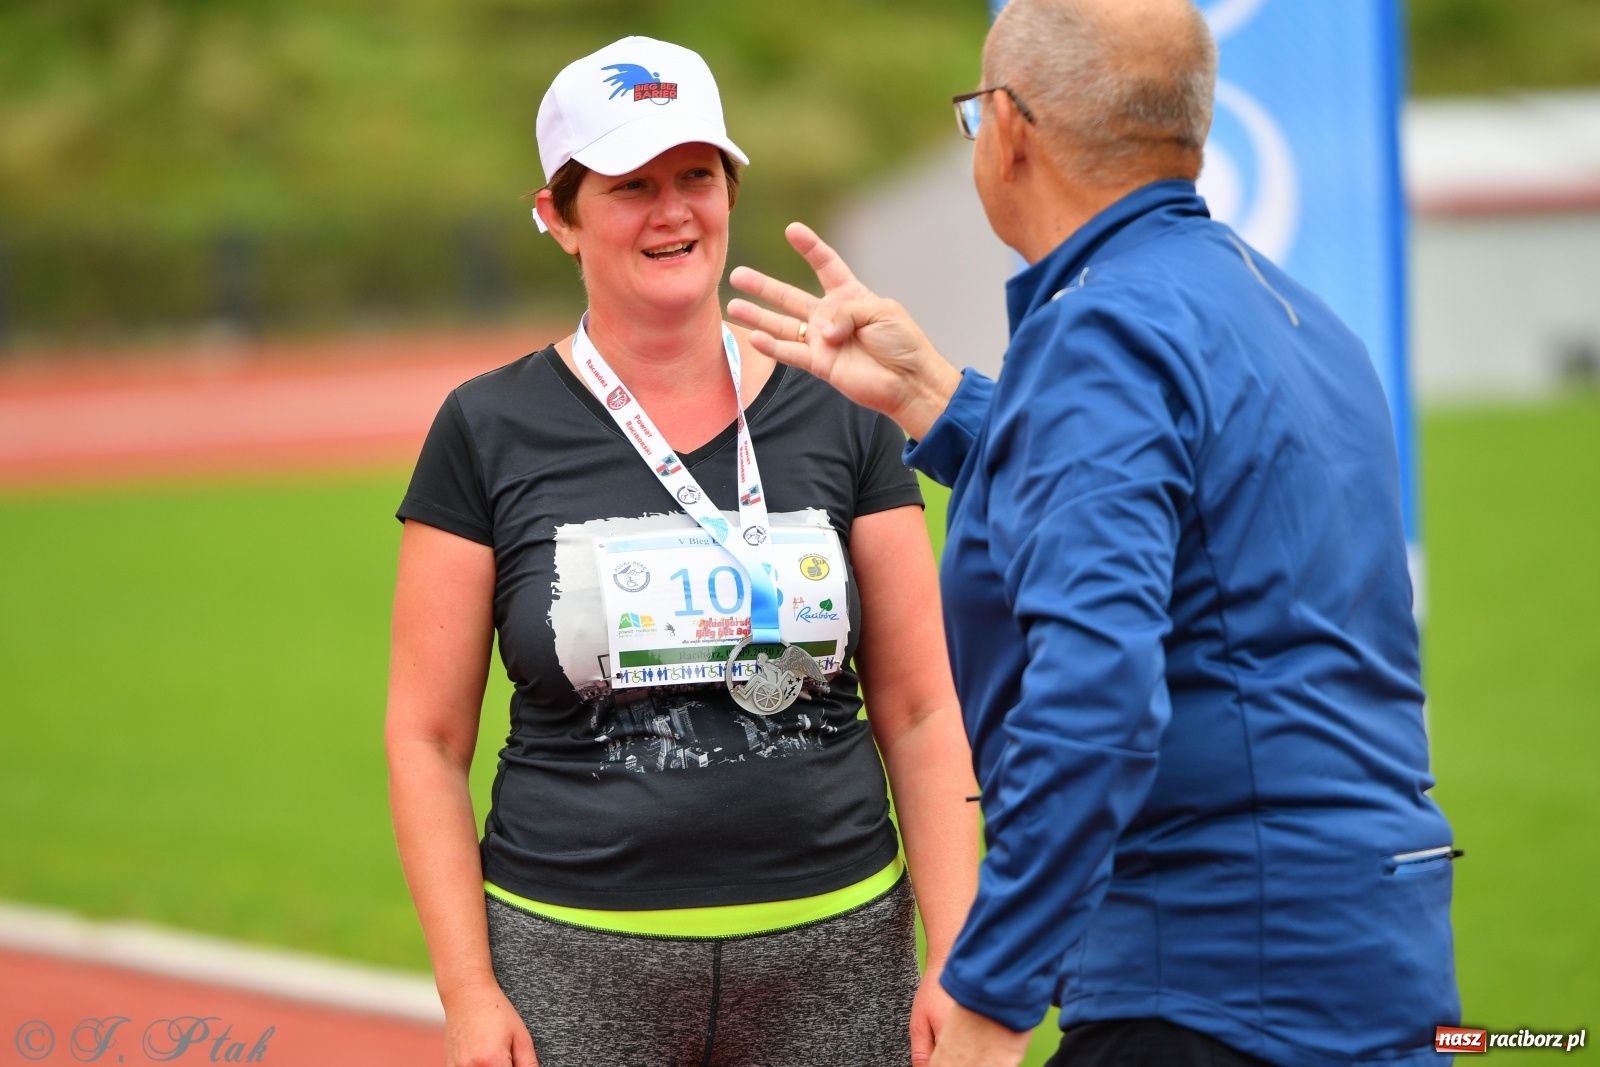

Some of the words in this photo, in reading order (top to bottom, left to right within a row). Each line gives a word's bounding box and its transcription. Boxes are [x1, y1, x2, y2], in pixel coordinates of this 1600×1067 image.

[634, 83, 658, 92] BIEG
[660, 83, 677, 91] BEZ
[634, 90, 677, 101] BARIER
[689, 537, 710, 546] Bieg
